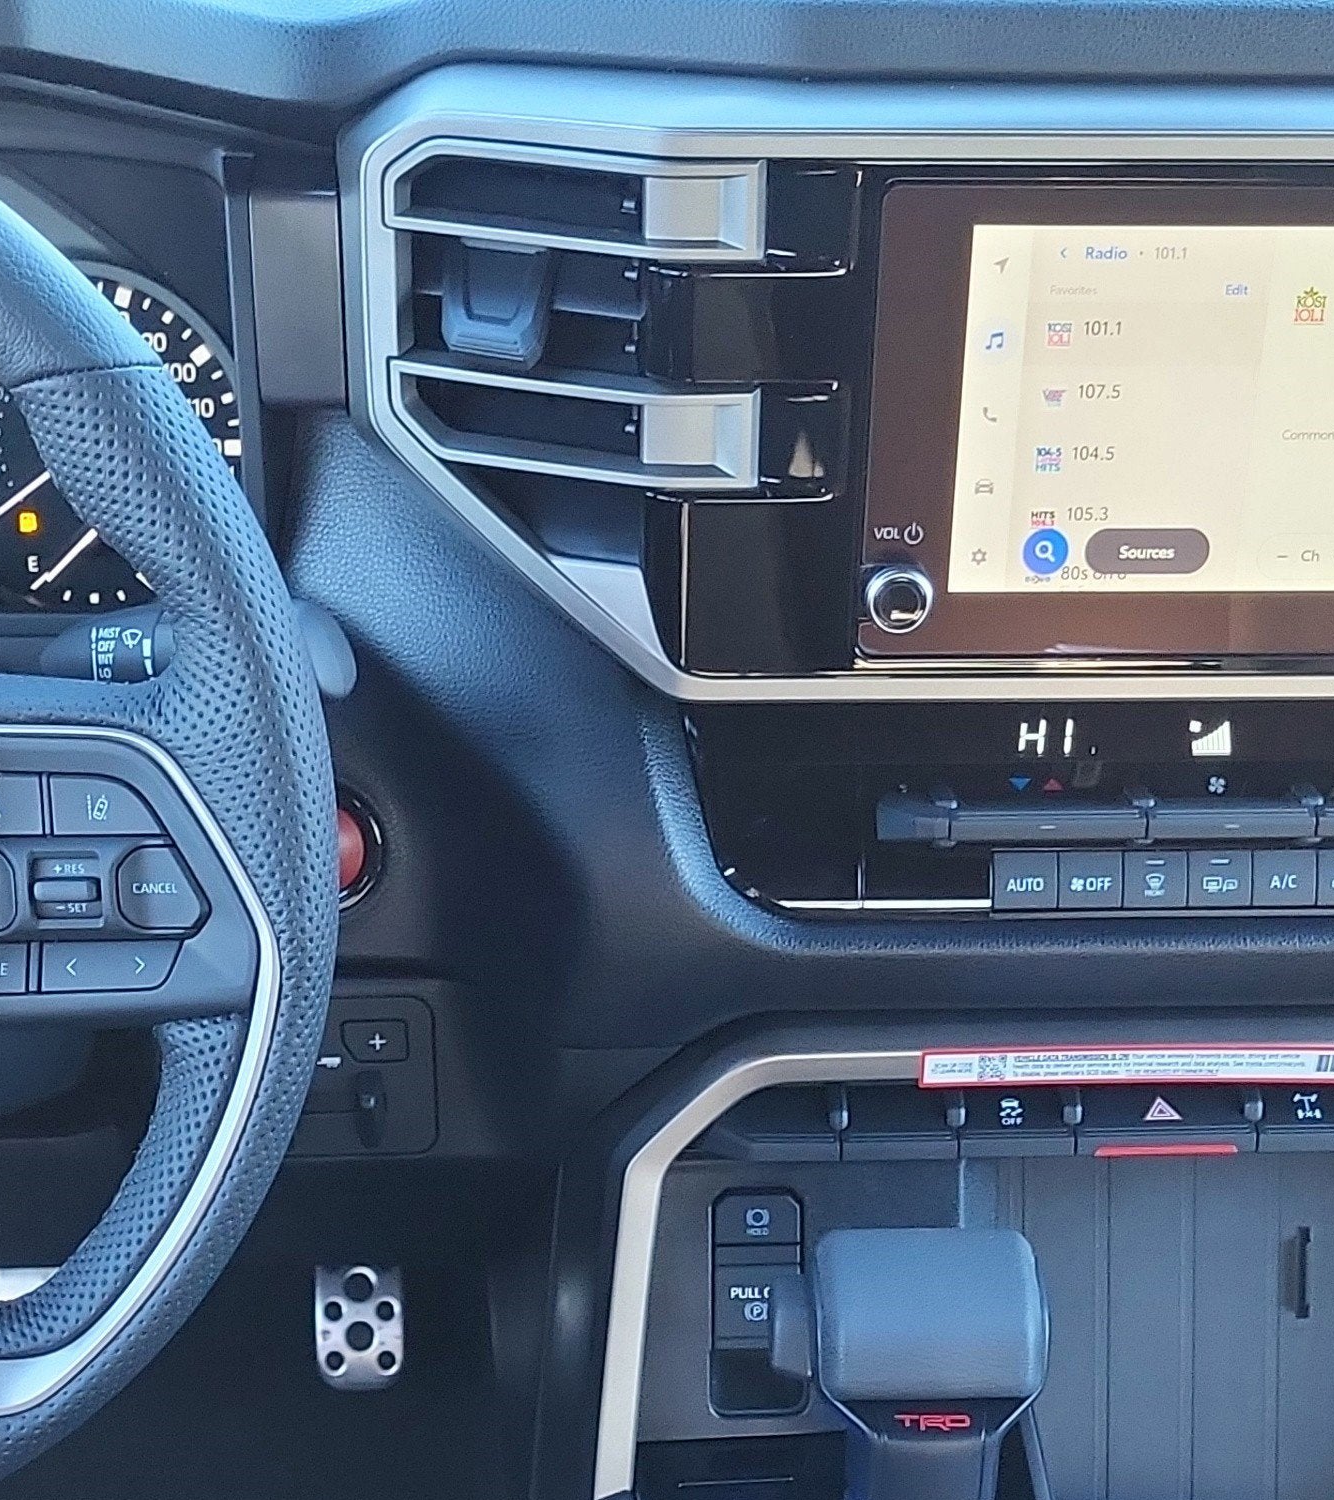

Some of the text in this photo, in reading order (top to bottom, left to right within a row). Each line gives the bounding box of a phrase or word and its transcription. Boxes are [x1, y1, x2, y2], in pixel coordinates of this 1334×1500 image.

[1085, 246, 1188, 260] Radio 101.1
[1049, 284, 1098, 296] Favorites
[1225, 284, 1249, 296] Edit
[1083, 321, 1122, 336] 101.1
[1078, 383, 1121, 399] 107.5
[1071, 446, 1115, 460] 104.5
[1031, 511, 1055, 520] HITS
[1067, 506, 1109, 521] 105.3
[873, 526, 900, 540] VOL
[1118, 545, 1176, 561] Sources
[1300, 550, 1320, 562] Ch
[28, 556, 39, 572] E
[98, 627, 120, 639] MIST
[98, 641, 116, 651] OFF
[98, 667, 112, 679] LO
[133, 883, 177, 894] CANCEL
[1006, 876, 1044, 892] AUTO
[1085, 877, 1113, 892] OFF
[1270, 874, 1297, 890] A/C
[730, 1287, 761, 1300] PULL
[894, 1414, 971, 1431] TRD
